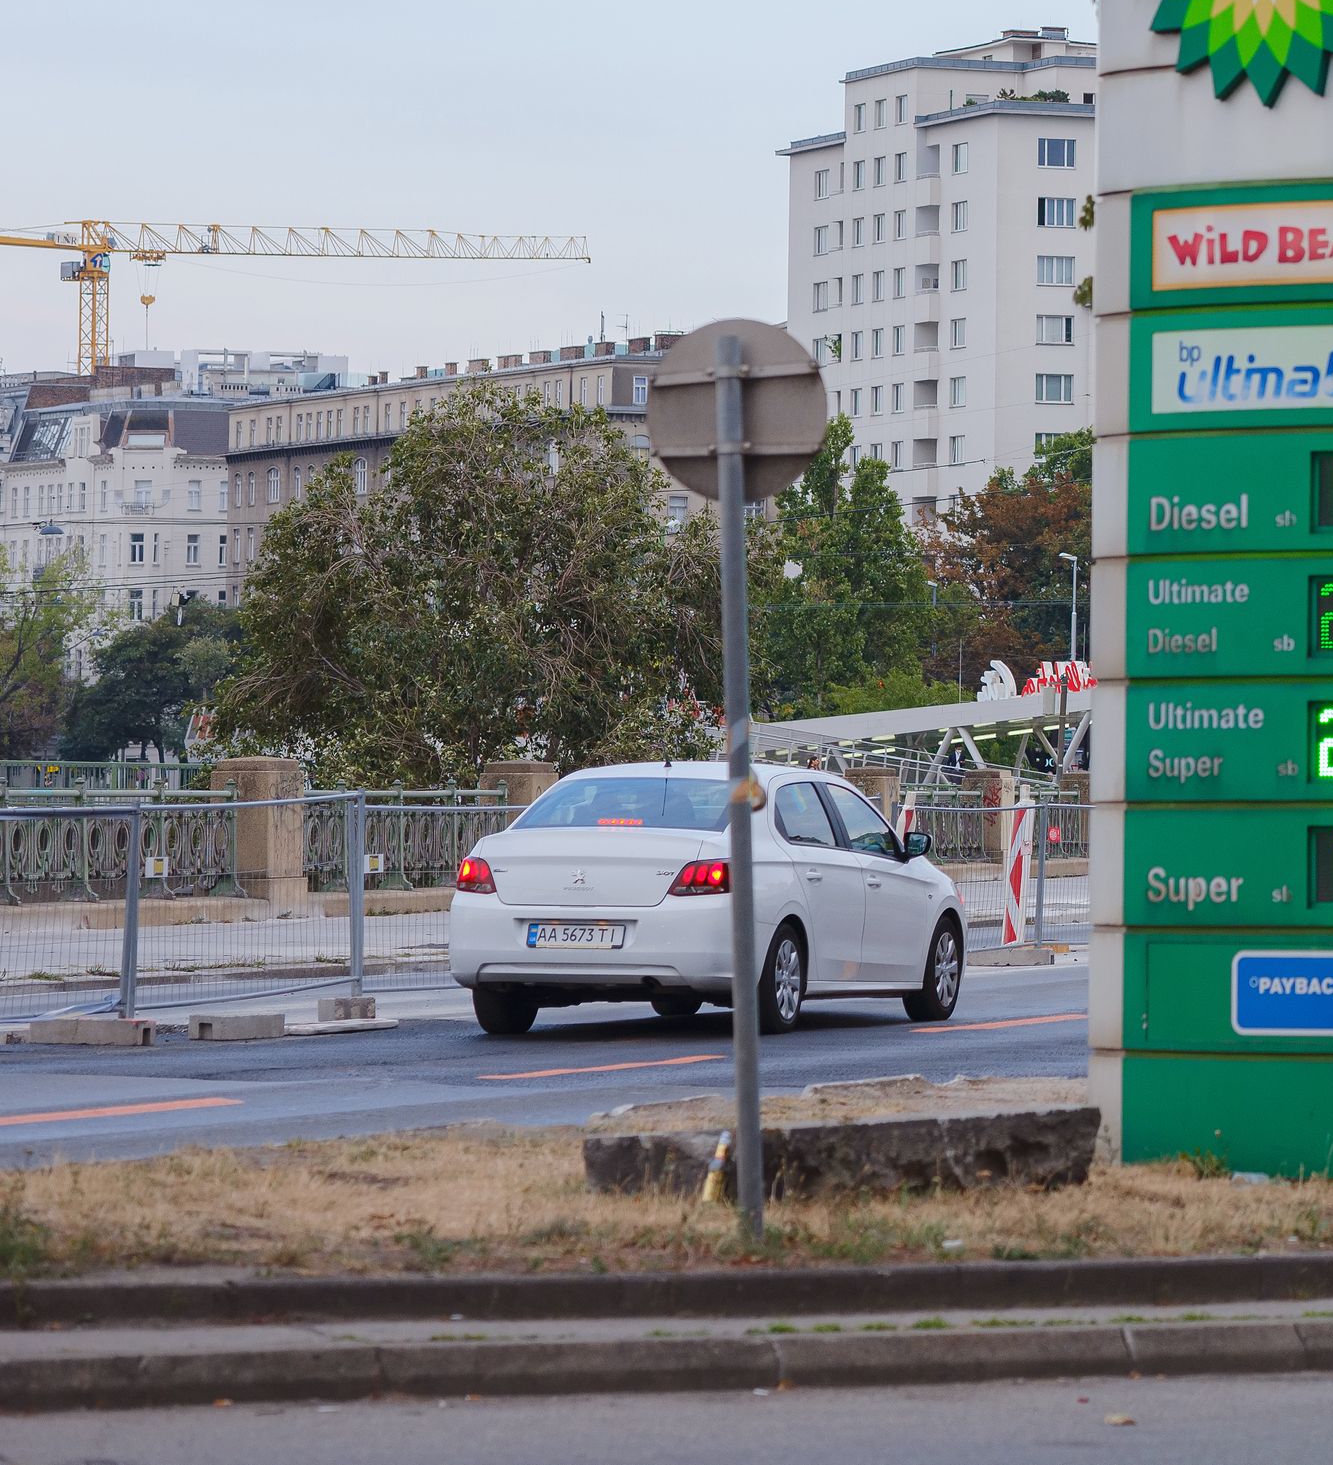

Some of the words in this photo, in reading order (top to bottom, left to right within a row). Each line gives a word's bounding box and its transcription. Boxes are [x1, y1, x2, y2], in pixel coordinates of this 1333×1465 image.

[1179, 340, 1201, 367] bp
[1150, 493, 1249, 531] Diesel
[1148, 578, 1249, 605] Ultimate
[1148, 626, 1218, 654] Diesel
[1148, 701, 1265, 730] Ultimate
[1148, 748, 1224, 784] Super
[1147, 866, 1244, 911] Super
[536, 927, 557, 942] AA
[561, 927, 595, 943] 5673
